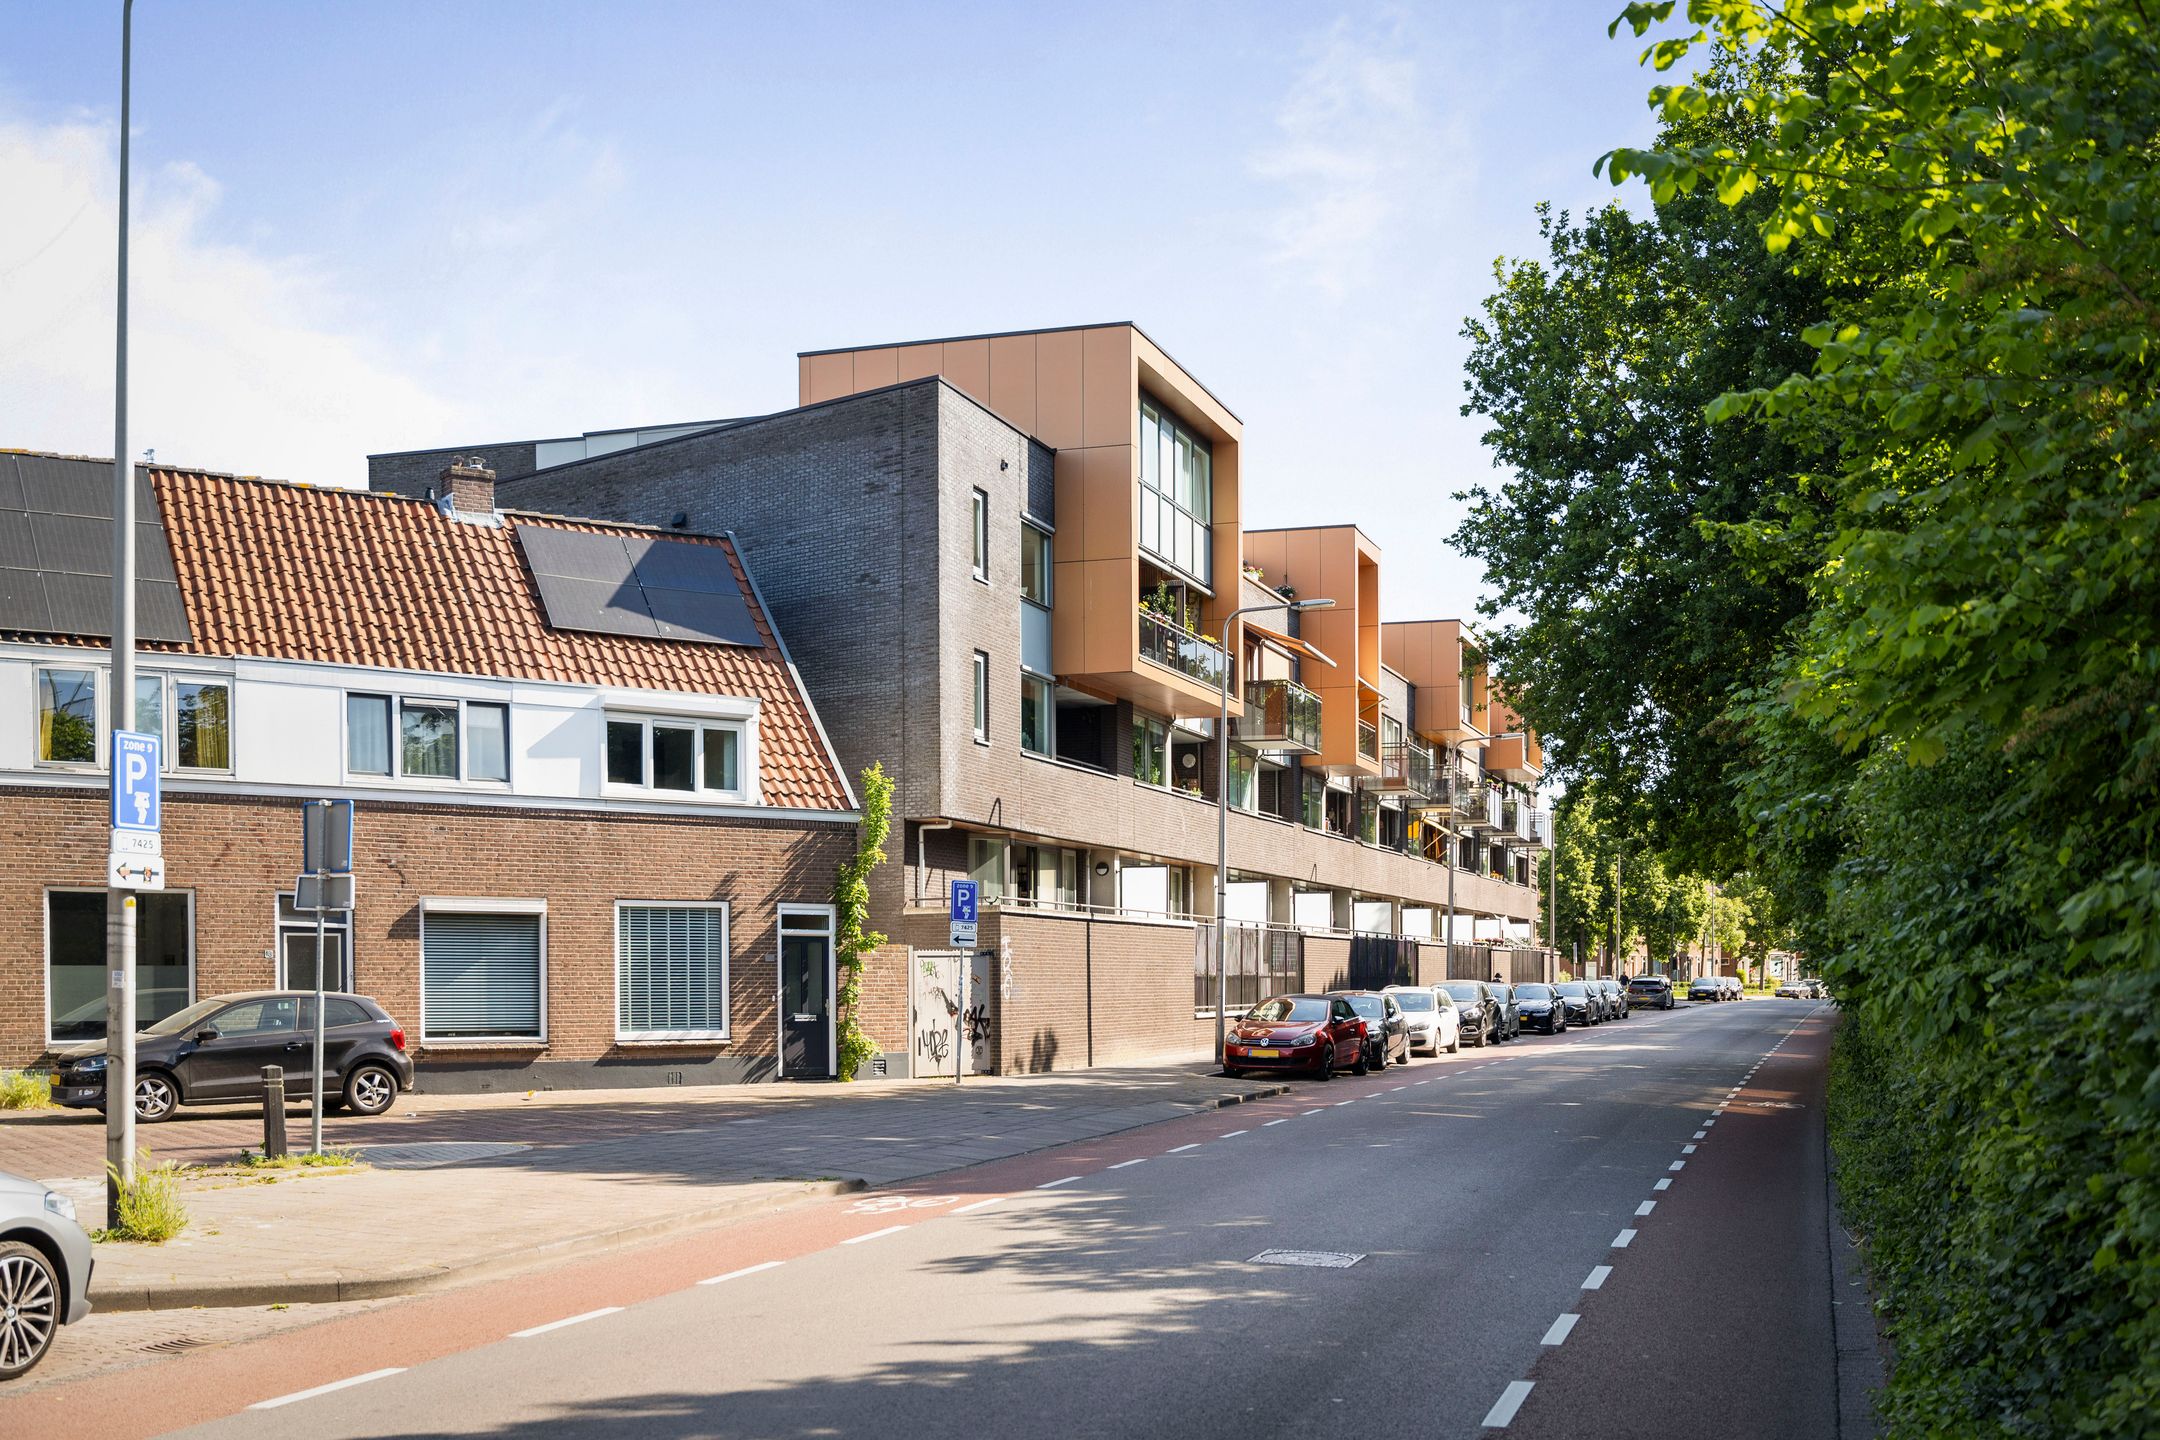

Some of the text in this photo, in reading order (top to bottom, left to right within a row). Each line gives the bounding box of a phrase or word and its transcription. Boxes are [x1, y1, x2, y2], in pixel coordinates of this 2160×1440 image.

[123, 740, 153, 753] zone 9
[126, 752, 148, 794] P
[132, 838, 154, 849] 7425
[957, 889, 970, 907] P
